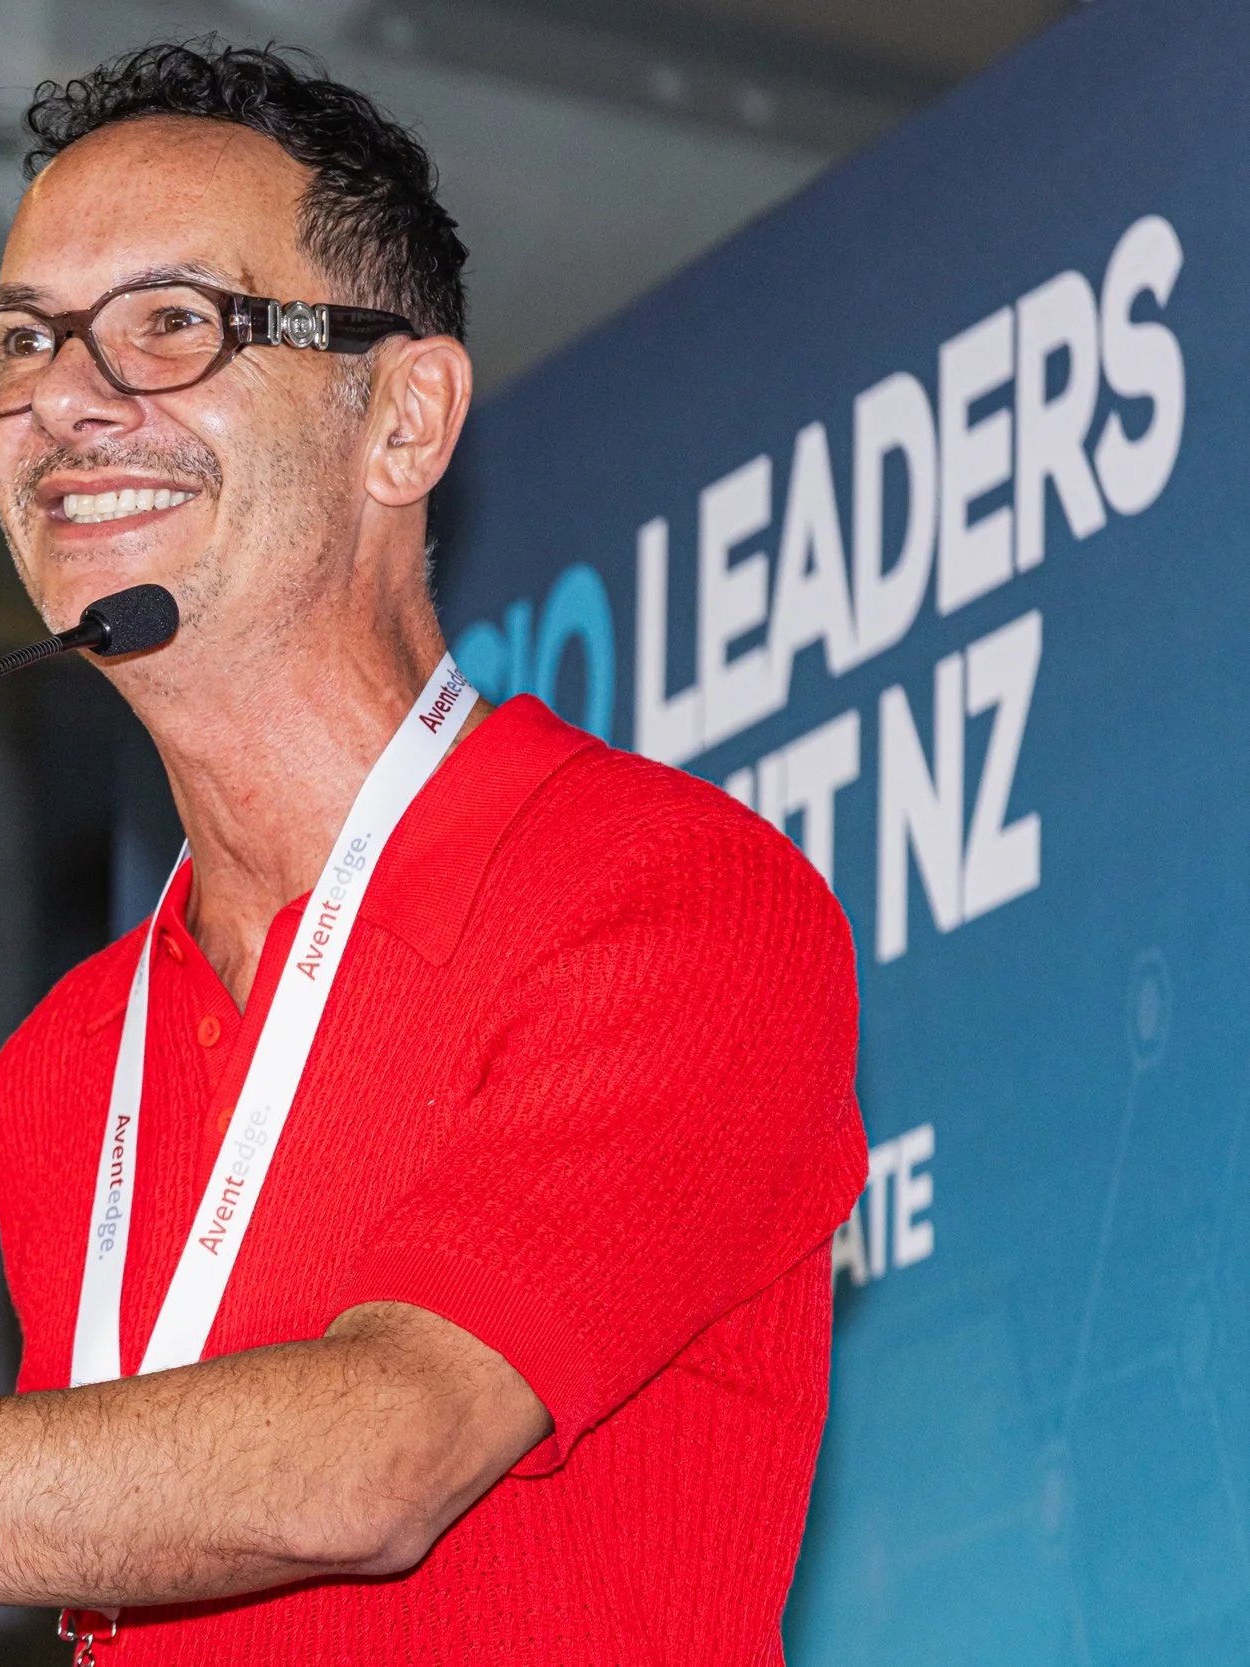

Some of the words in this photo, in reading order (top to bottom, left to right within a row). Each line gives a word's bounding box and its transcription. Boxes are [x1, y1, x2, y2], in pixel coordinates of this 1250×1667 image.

[635, 214, 1186, 767] LEADERS
[297, 831, 372, 981] Aventedge.
[876, 609, 1044, 964] NZ
[97, 1114, 131, 1260] Aventedge.
